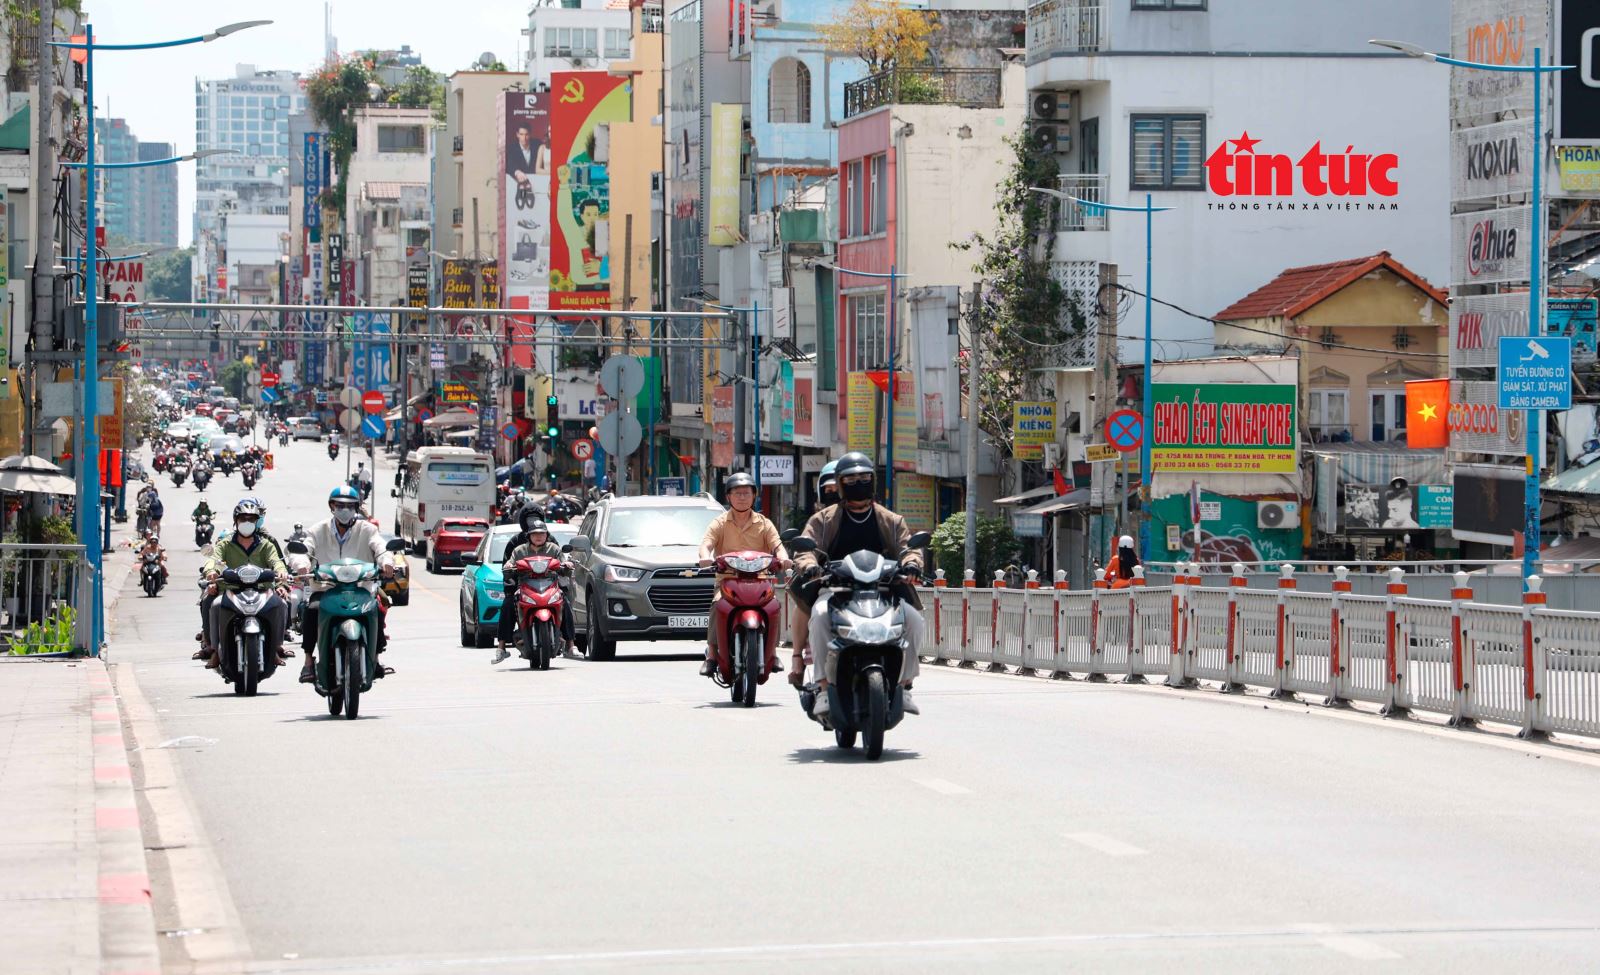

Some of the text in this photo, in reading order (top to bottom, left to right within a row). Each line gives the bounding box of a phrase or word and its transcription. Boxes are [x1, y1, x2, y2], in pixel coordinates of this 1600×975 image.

[1467, 137, 1519, 180] KIOXIA
[1506, 364, 1565, 377] TUYẾN ĐƯỜNG CÓ
[1503, 380, 1520, 391] GIÁM
[1549, 381, 1568, 394] PHẠT
[1511, 392, 1560, 407] BẰNG CAMERA
[1019, 404, 1053, 417] NHÔM
[1153, 388, 1292, 446] CHÁO ẾCH SINGAPORE
[775, 459, 792, 469] VIP
